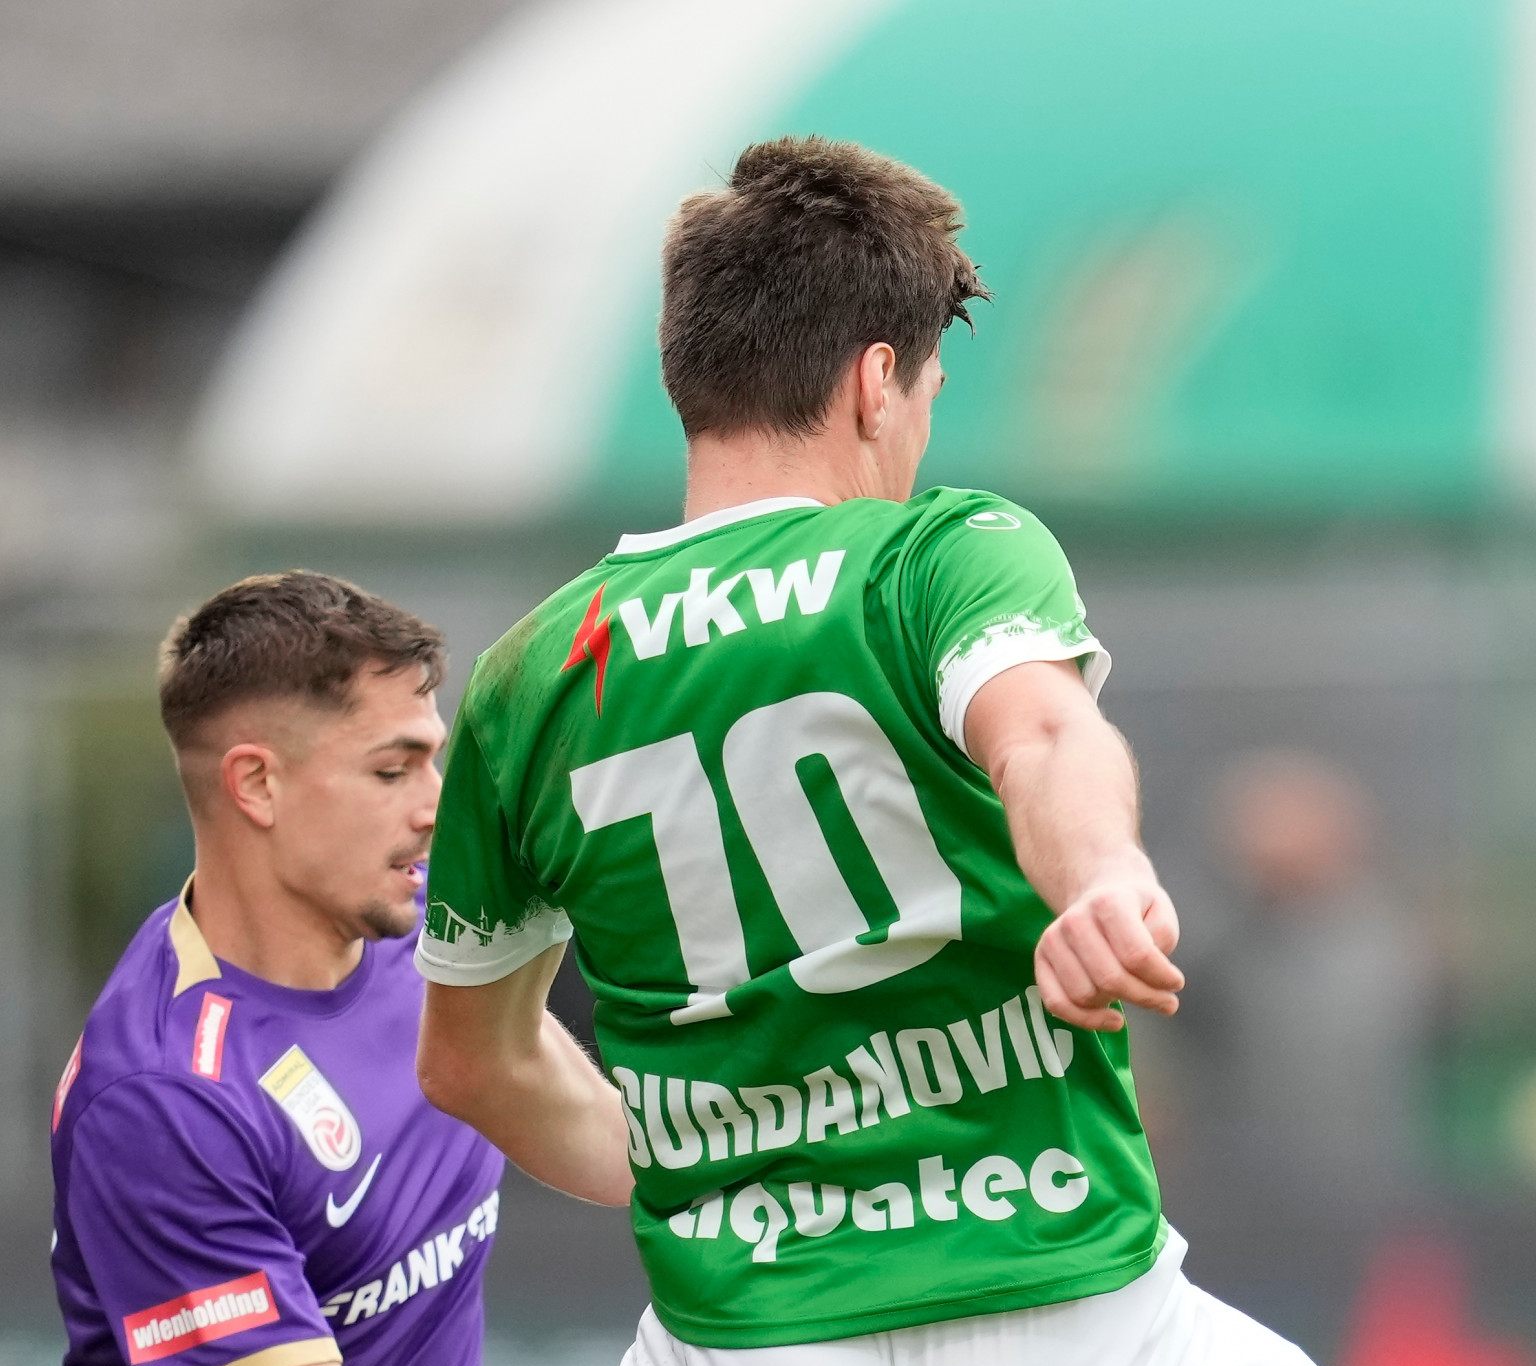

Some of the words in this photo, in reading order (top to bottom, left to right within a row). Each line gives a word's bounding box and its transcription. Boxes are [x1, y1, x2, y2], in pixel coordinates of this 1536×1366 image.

[618, 549, 847, 661] vkw
[570, 692, 962, 1026] 70
[132, 1286, 270, 1350] wienholding
